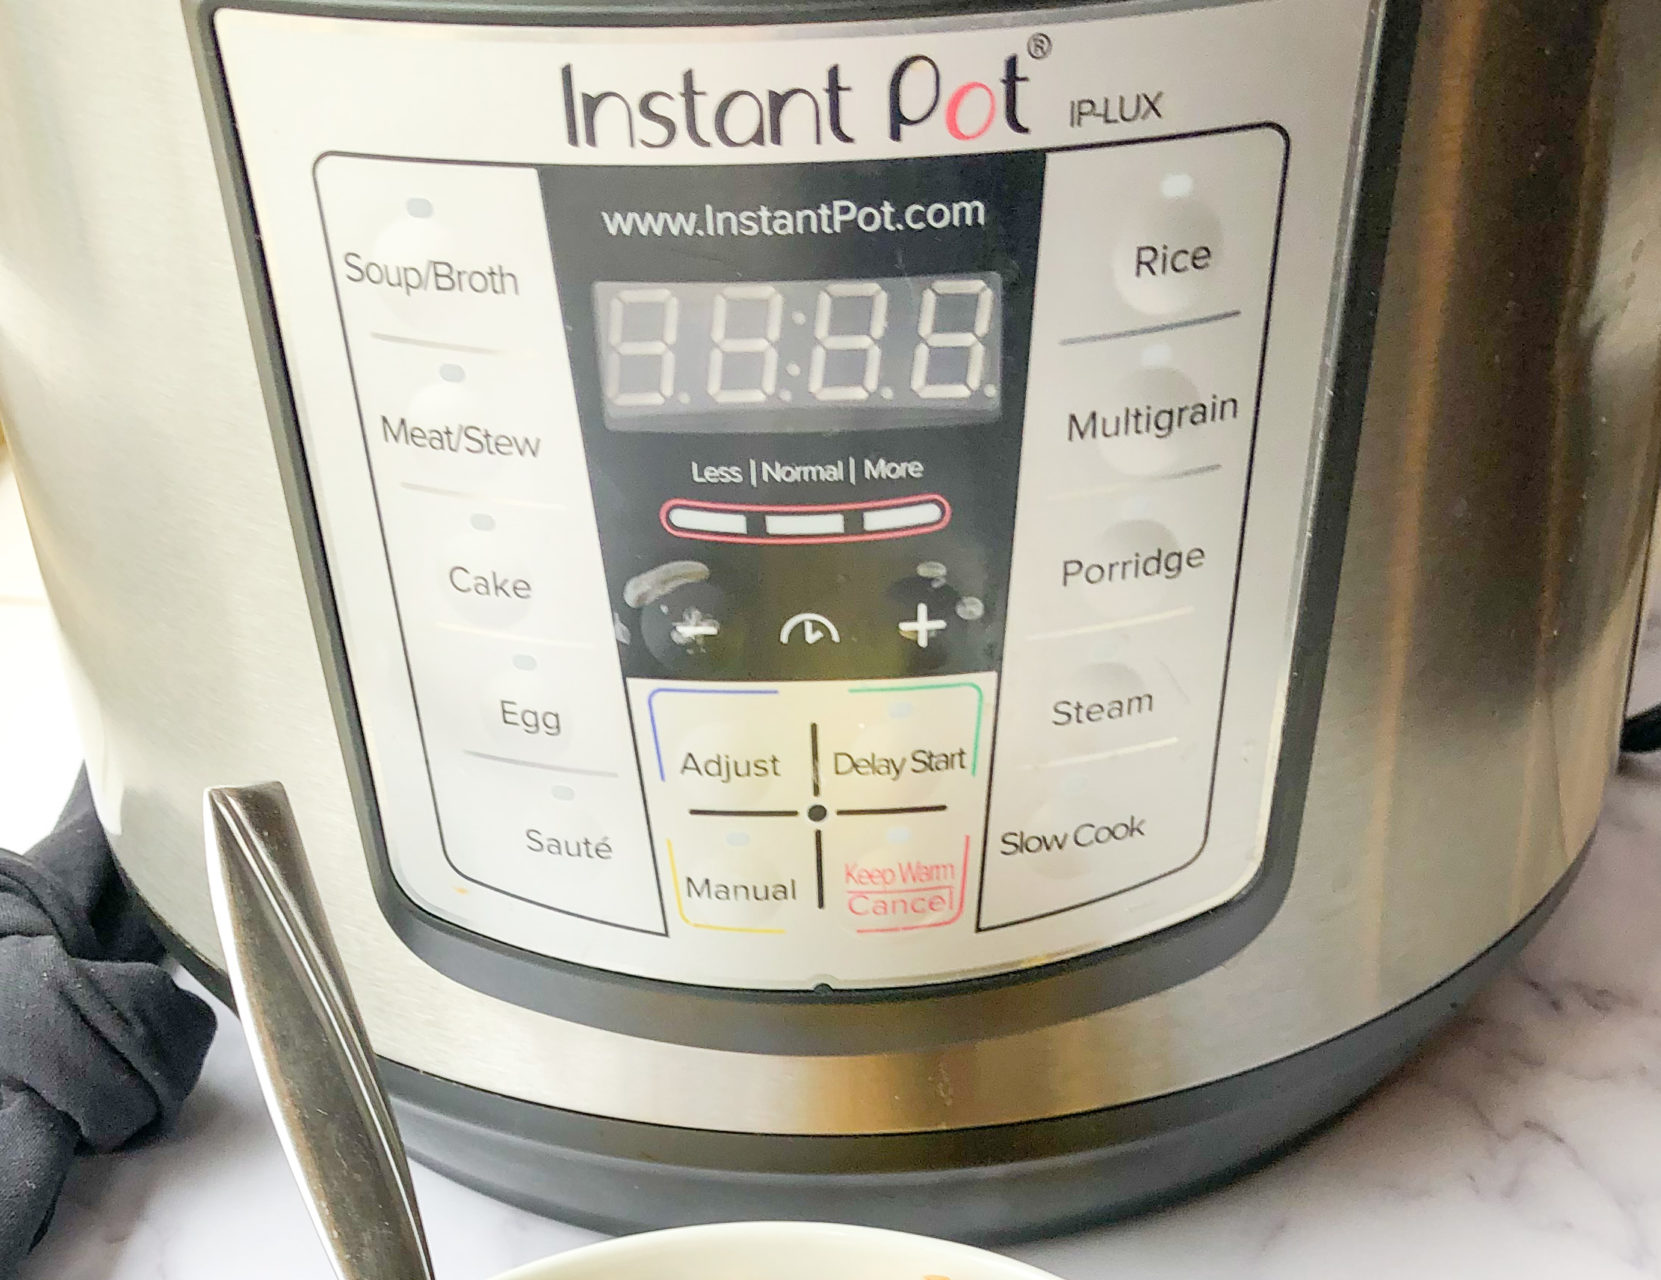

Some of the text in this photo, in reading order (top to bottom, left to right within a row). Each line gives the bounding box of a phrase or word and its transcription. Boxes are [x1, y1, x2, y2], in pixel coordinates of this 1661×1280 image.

[560, 63, 853, 148] Instant
[1069, 92, 1164, 127] IP-LUX
[602, 198, 986, 238] www.InstantPot.com
[344, 252, 520, 297] Soup/Broth
[1135, 244, 1212, 277] Rice
[1067, 394, 1239, 442] Multigrain
[381, 415, 541, 458] Meat/Stew
[692, 460, 743, 483] Less
[761, 459, 843, 483] Normal
[864, 459, 924, 482] More
[448, 566, 532, 599] Cake
[1061, 545, 1206, 587] Porridge
[500, 700, 562, 736] Egg
[1052, 691, 1154, 725] Steam
[680, 752, 782, 780] Adjust
[833, 747, 967, 780] Delay Start
[526, 828, 613, 860] Sauté
[1001, 814, 1146, 856] Slow Cook
[686, 876, 797, 901] Manual
[845, 862, 956, 886] Keep Warm
[847, 890, 954, 916] Cancel
